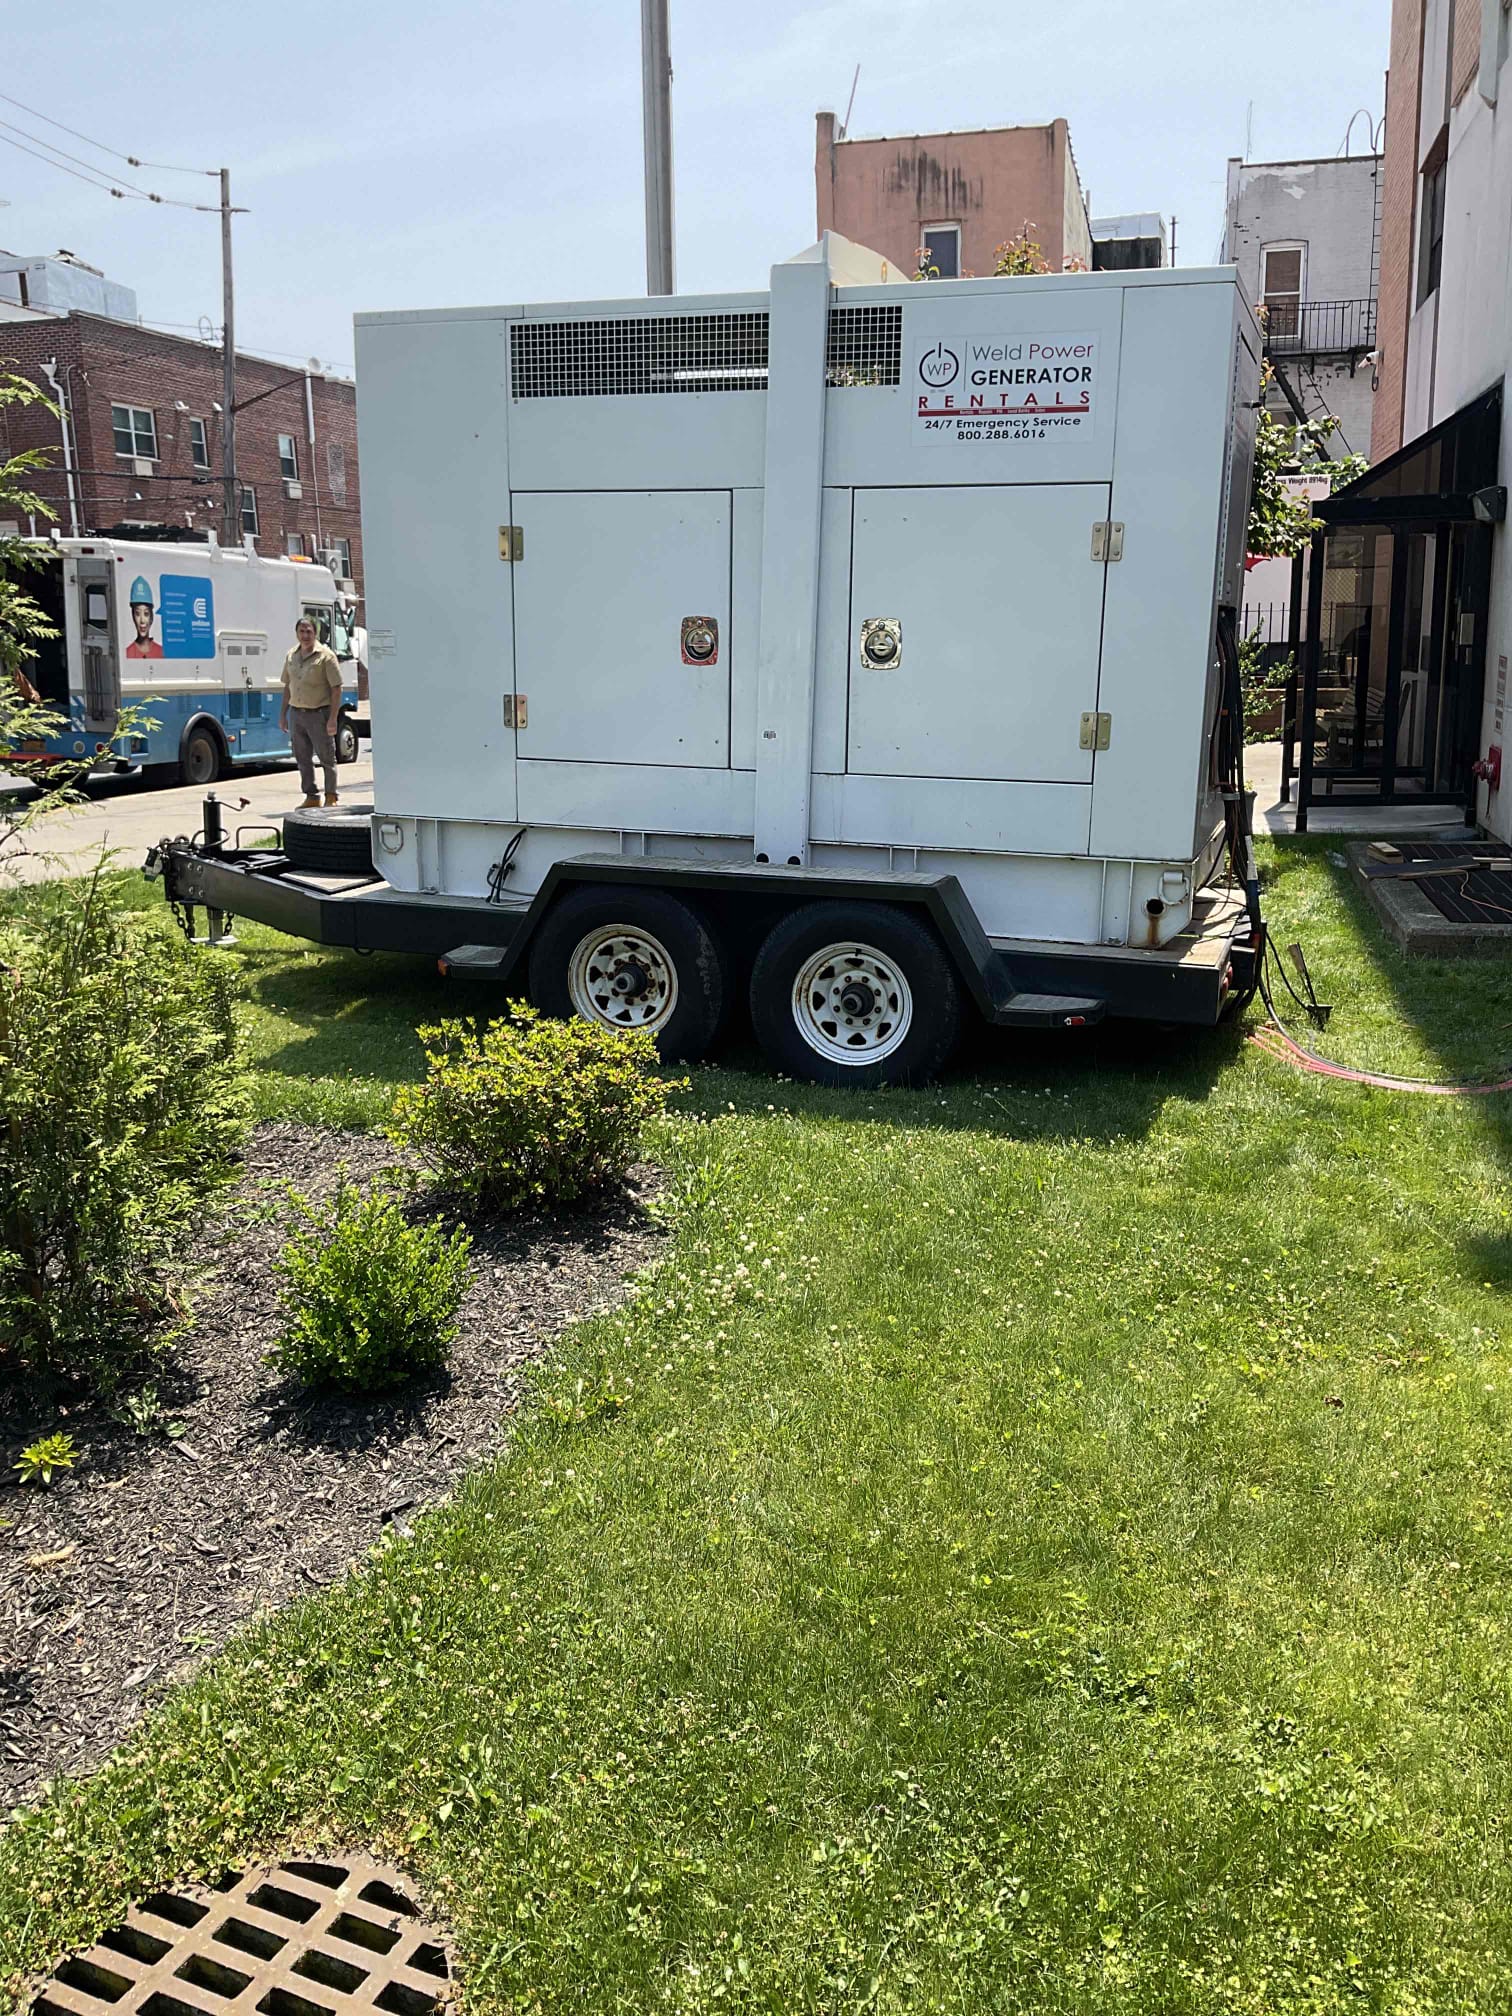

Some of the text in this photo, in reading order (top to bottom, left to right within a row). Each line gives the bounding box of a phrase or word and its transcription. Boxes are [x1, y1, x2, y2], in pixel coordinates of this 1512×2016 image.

[973, 343, 1094, 361] Weld Power
[927, 362, 952, 376] WP
[971, 366, 1092, 386] GENERATOR
[918, 391, 1090, 409] RENTALS
[924, 417, 1081, 431] 24/7 Emergency Service
[957, 429, 1046, 440] 800.288.6016
